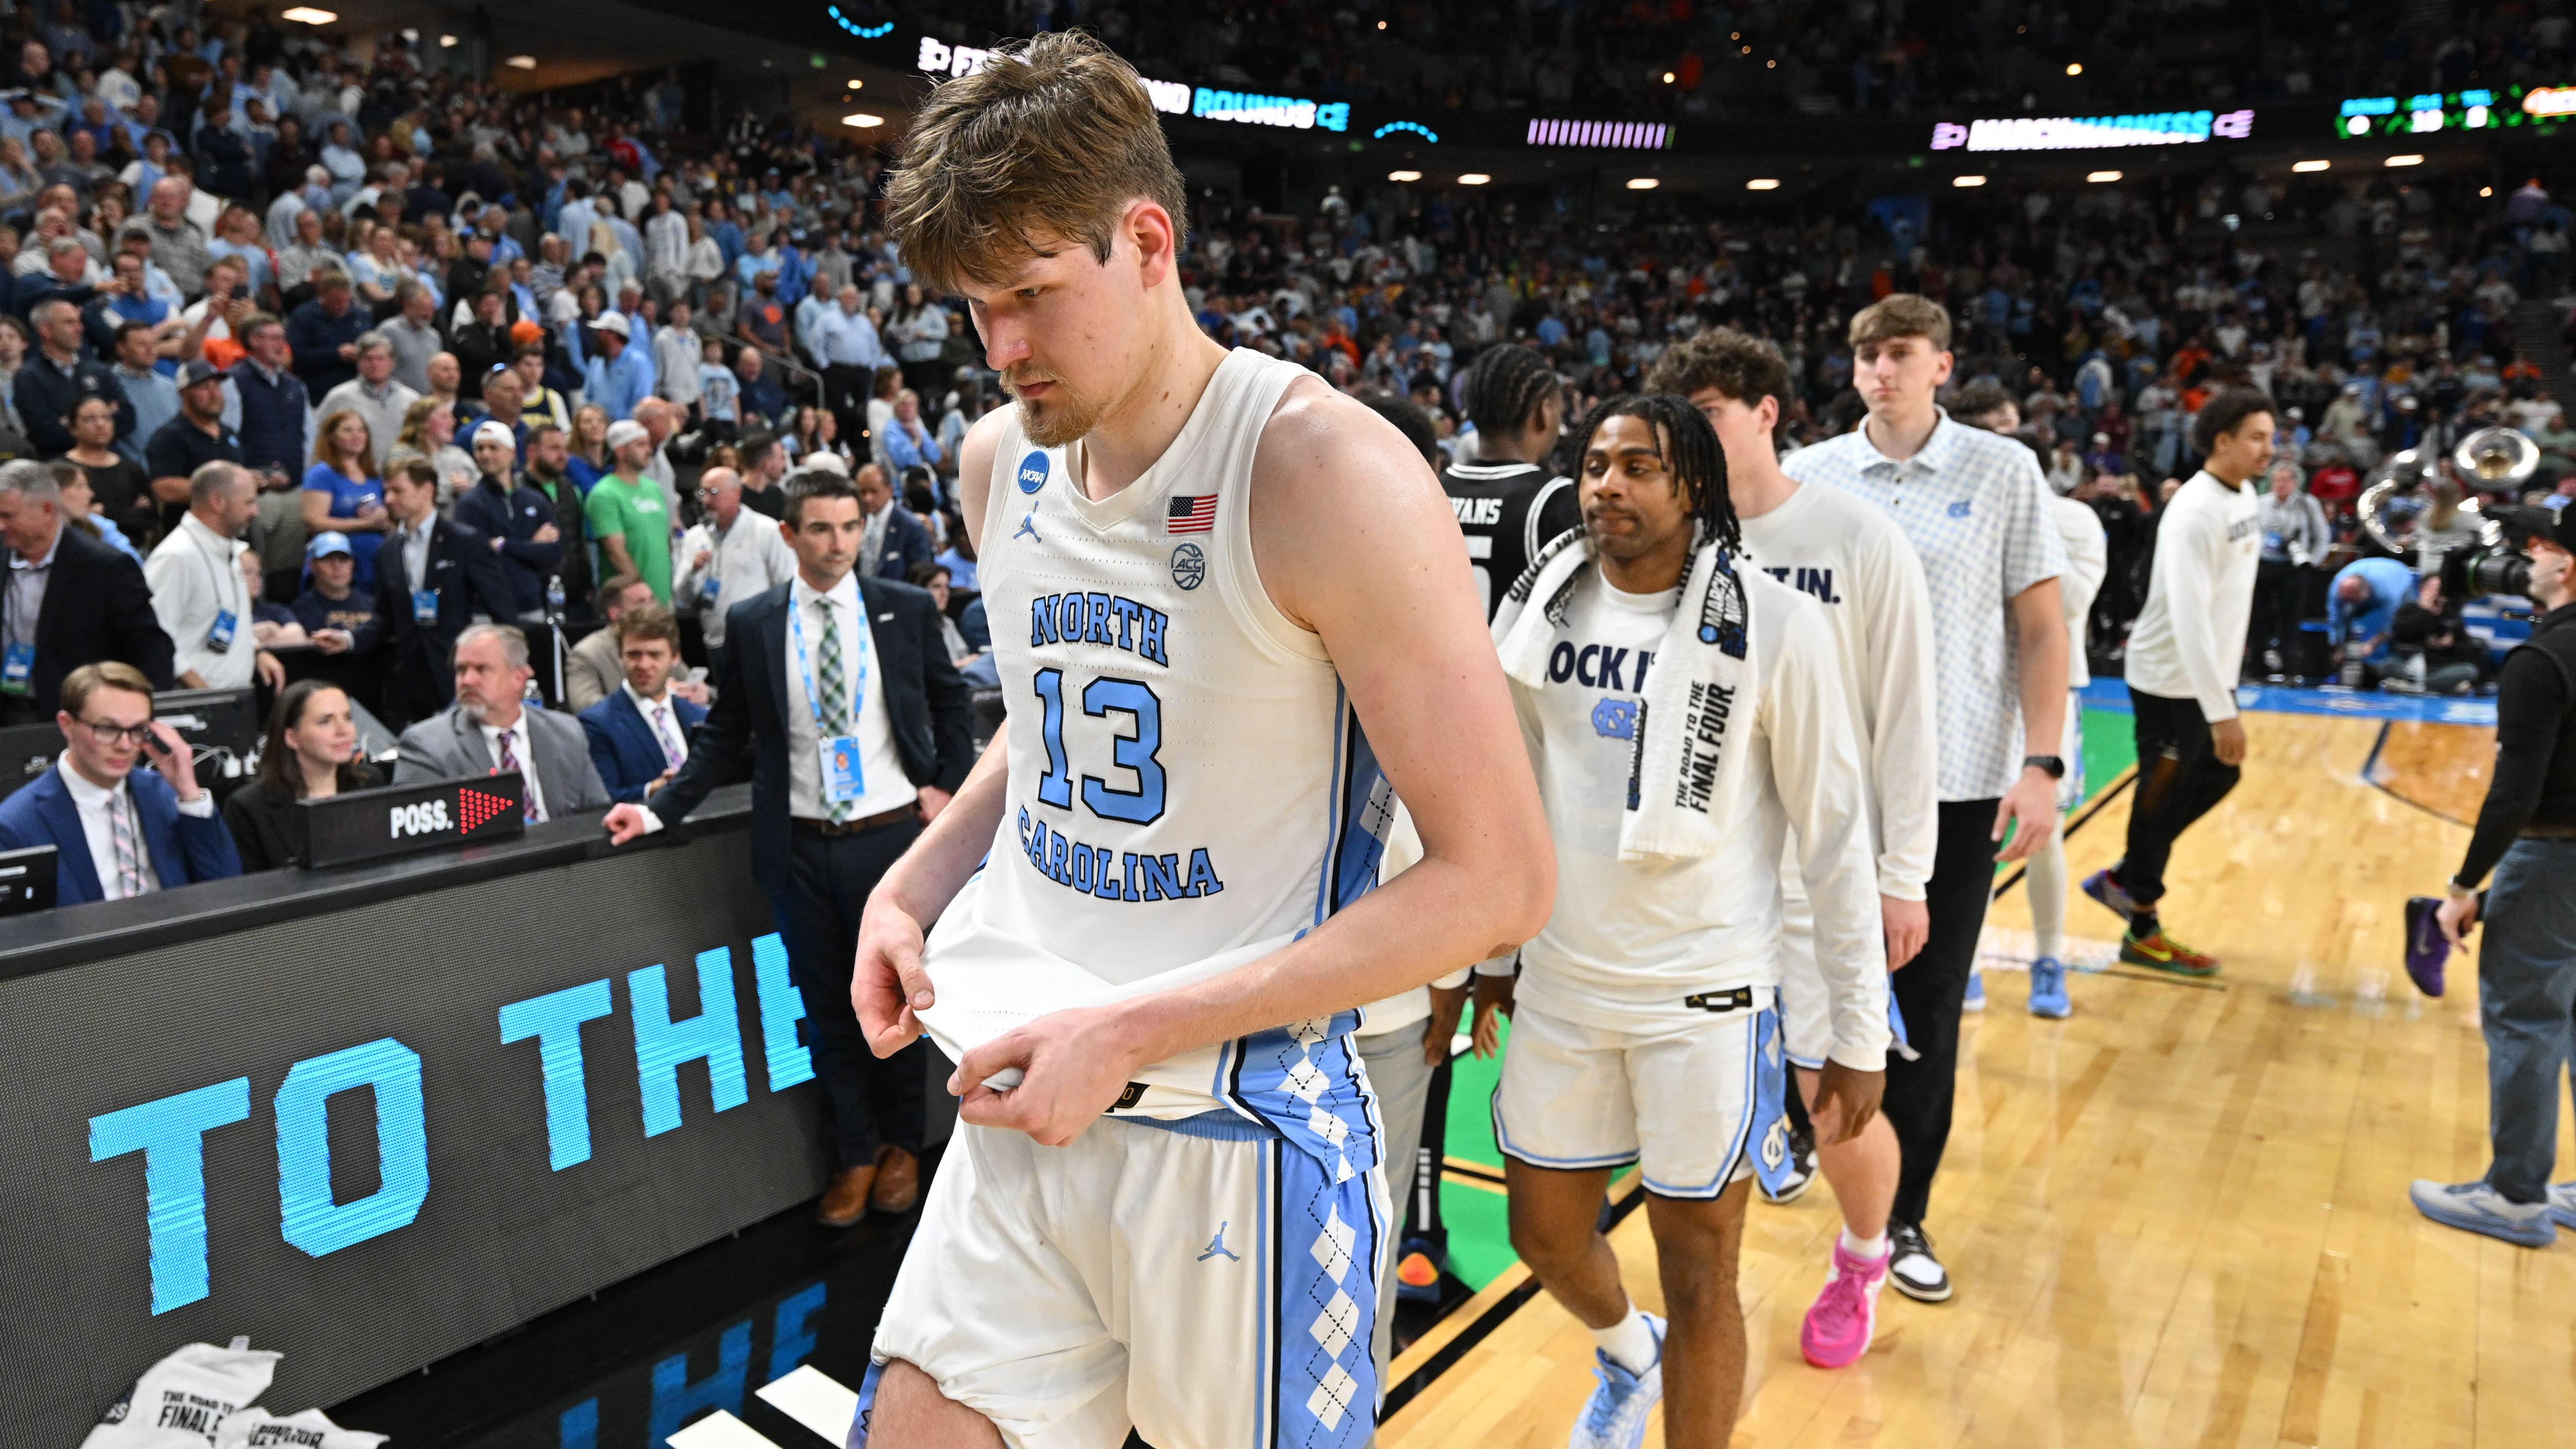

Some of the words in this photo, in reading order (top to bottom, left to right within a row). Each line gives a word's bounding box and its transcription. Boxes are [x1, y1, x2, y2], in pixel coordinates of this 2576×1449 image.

[1020, 468, 1045, 483] NCAA
[1447, 496, 1503, 525] VANS
[1175, 558, 1205, 569] ACC
[1762, 568, 1790, 583] T
[1797, 568, 1840, 603] IN.
[1031, 592, 1168, 668] NORTH
[1545, 641, 1629, 691] OCK
[1689, 679, 1705, 710] THE
[1686, 713, 1697, 732] TO
[1034, 667, 1166, 827] 13
[1680, 736, 1693, 778] ROAD
[1675, 780, 1689, 808] THE
[1689, 751, 1719, 814] FINAL
[391, 799, 454, 838] POSS.
[1018, 804, 1224, 902] CAROLINA
[89, 1036, 430, 1315] TO
[163, 1390, 184, 1402] THE
